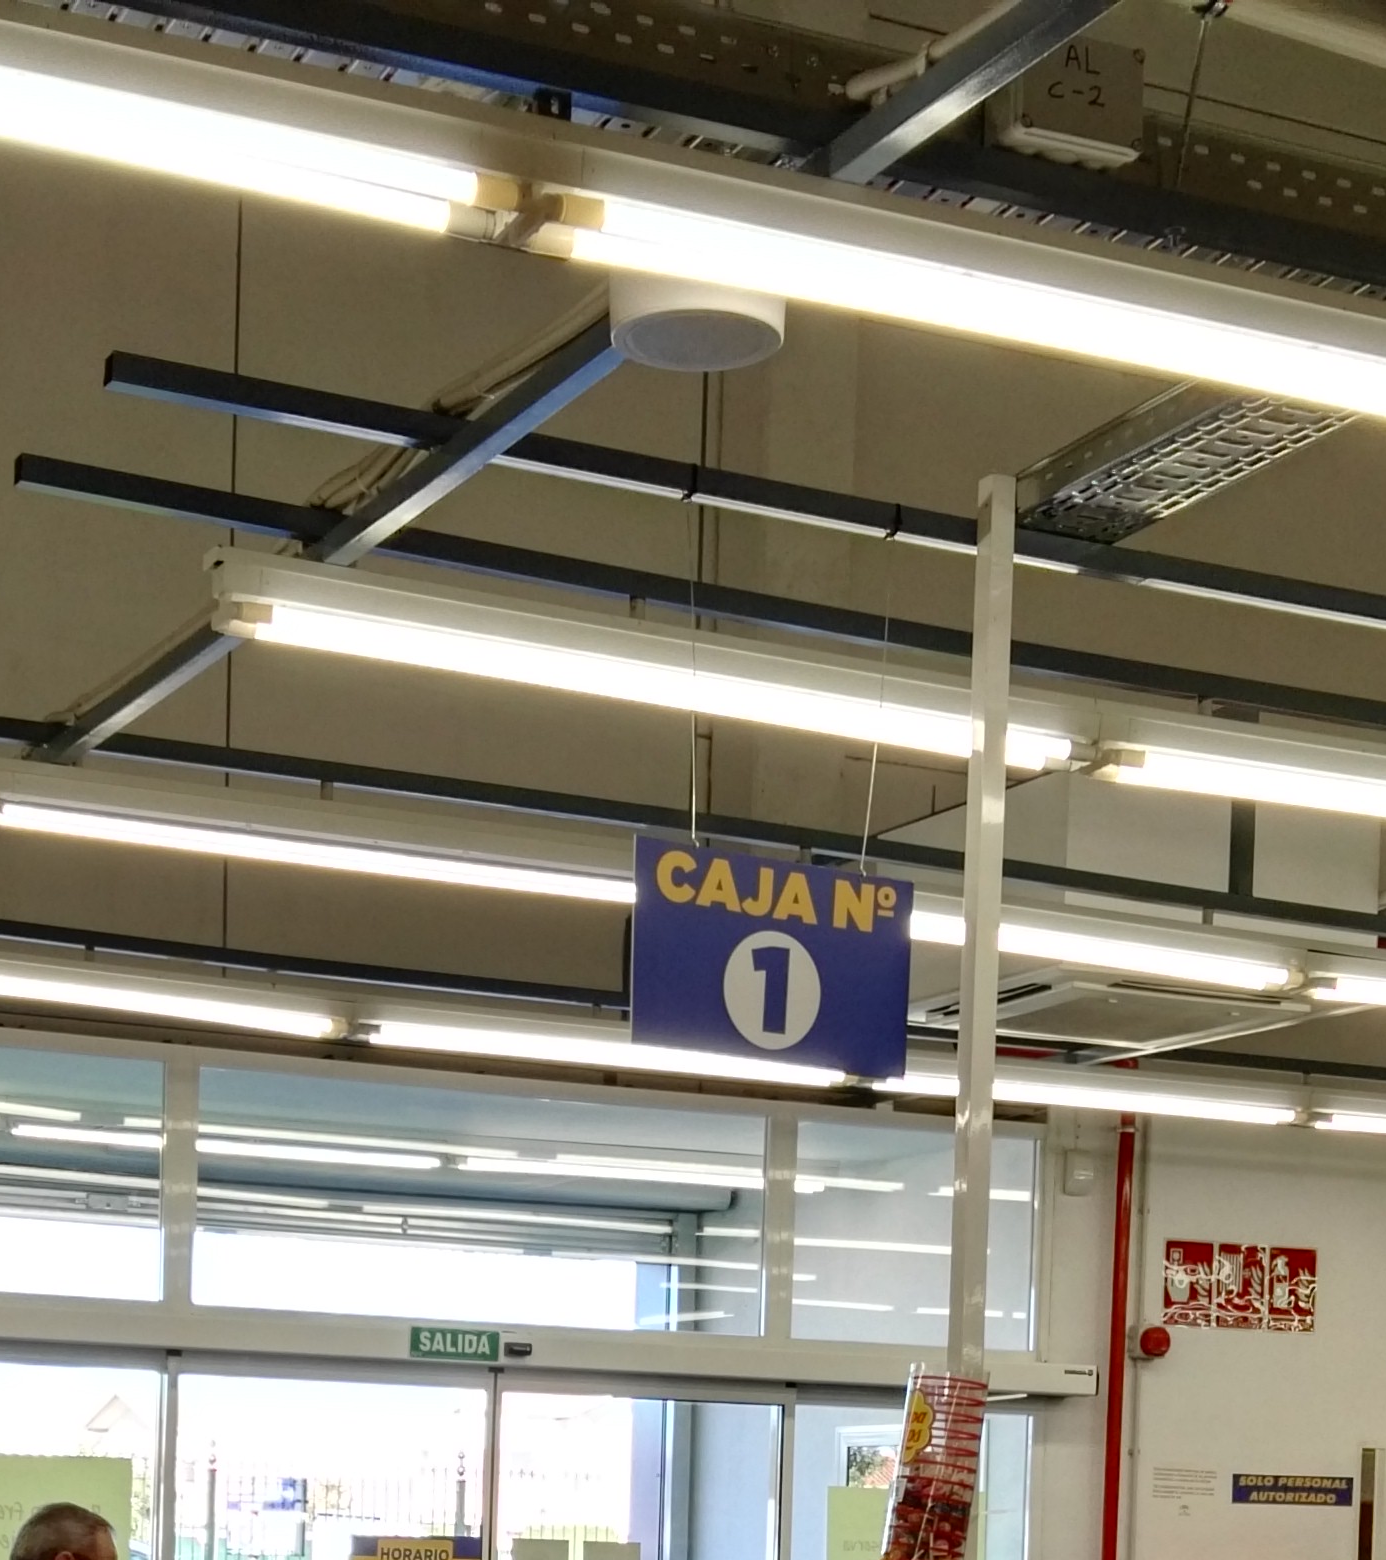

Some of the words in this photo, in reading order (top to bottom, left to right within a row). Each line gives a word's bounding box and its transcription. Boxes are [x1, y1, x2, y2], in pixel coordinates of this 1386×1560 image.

[1065, 44, 1101, 76] AL
[656, 850, 818, 926] CAJA
[832, 877, 898, 934] Nº
[751, 946, 791, 1035] 1
[418, 1331, 492, 1356] SALIDA
[1238, 1475, 1274, 1488] SOLO
[1277, 1476, 1349, 1490] PERSONAL
[1248, 1490, 1338, 1505] AUTORIZADO
